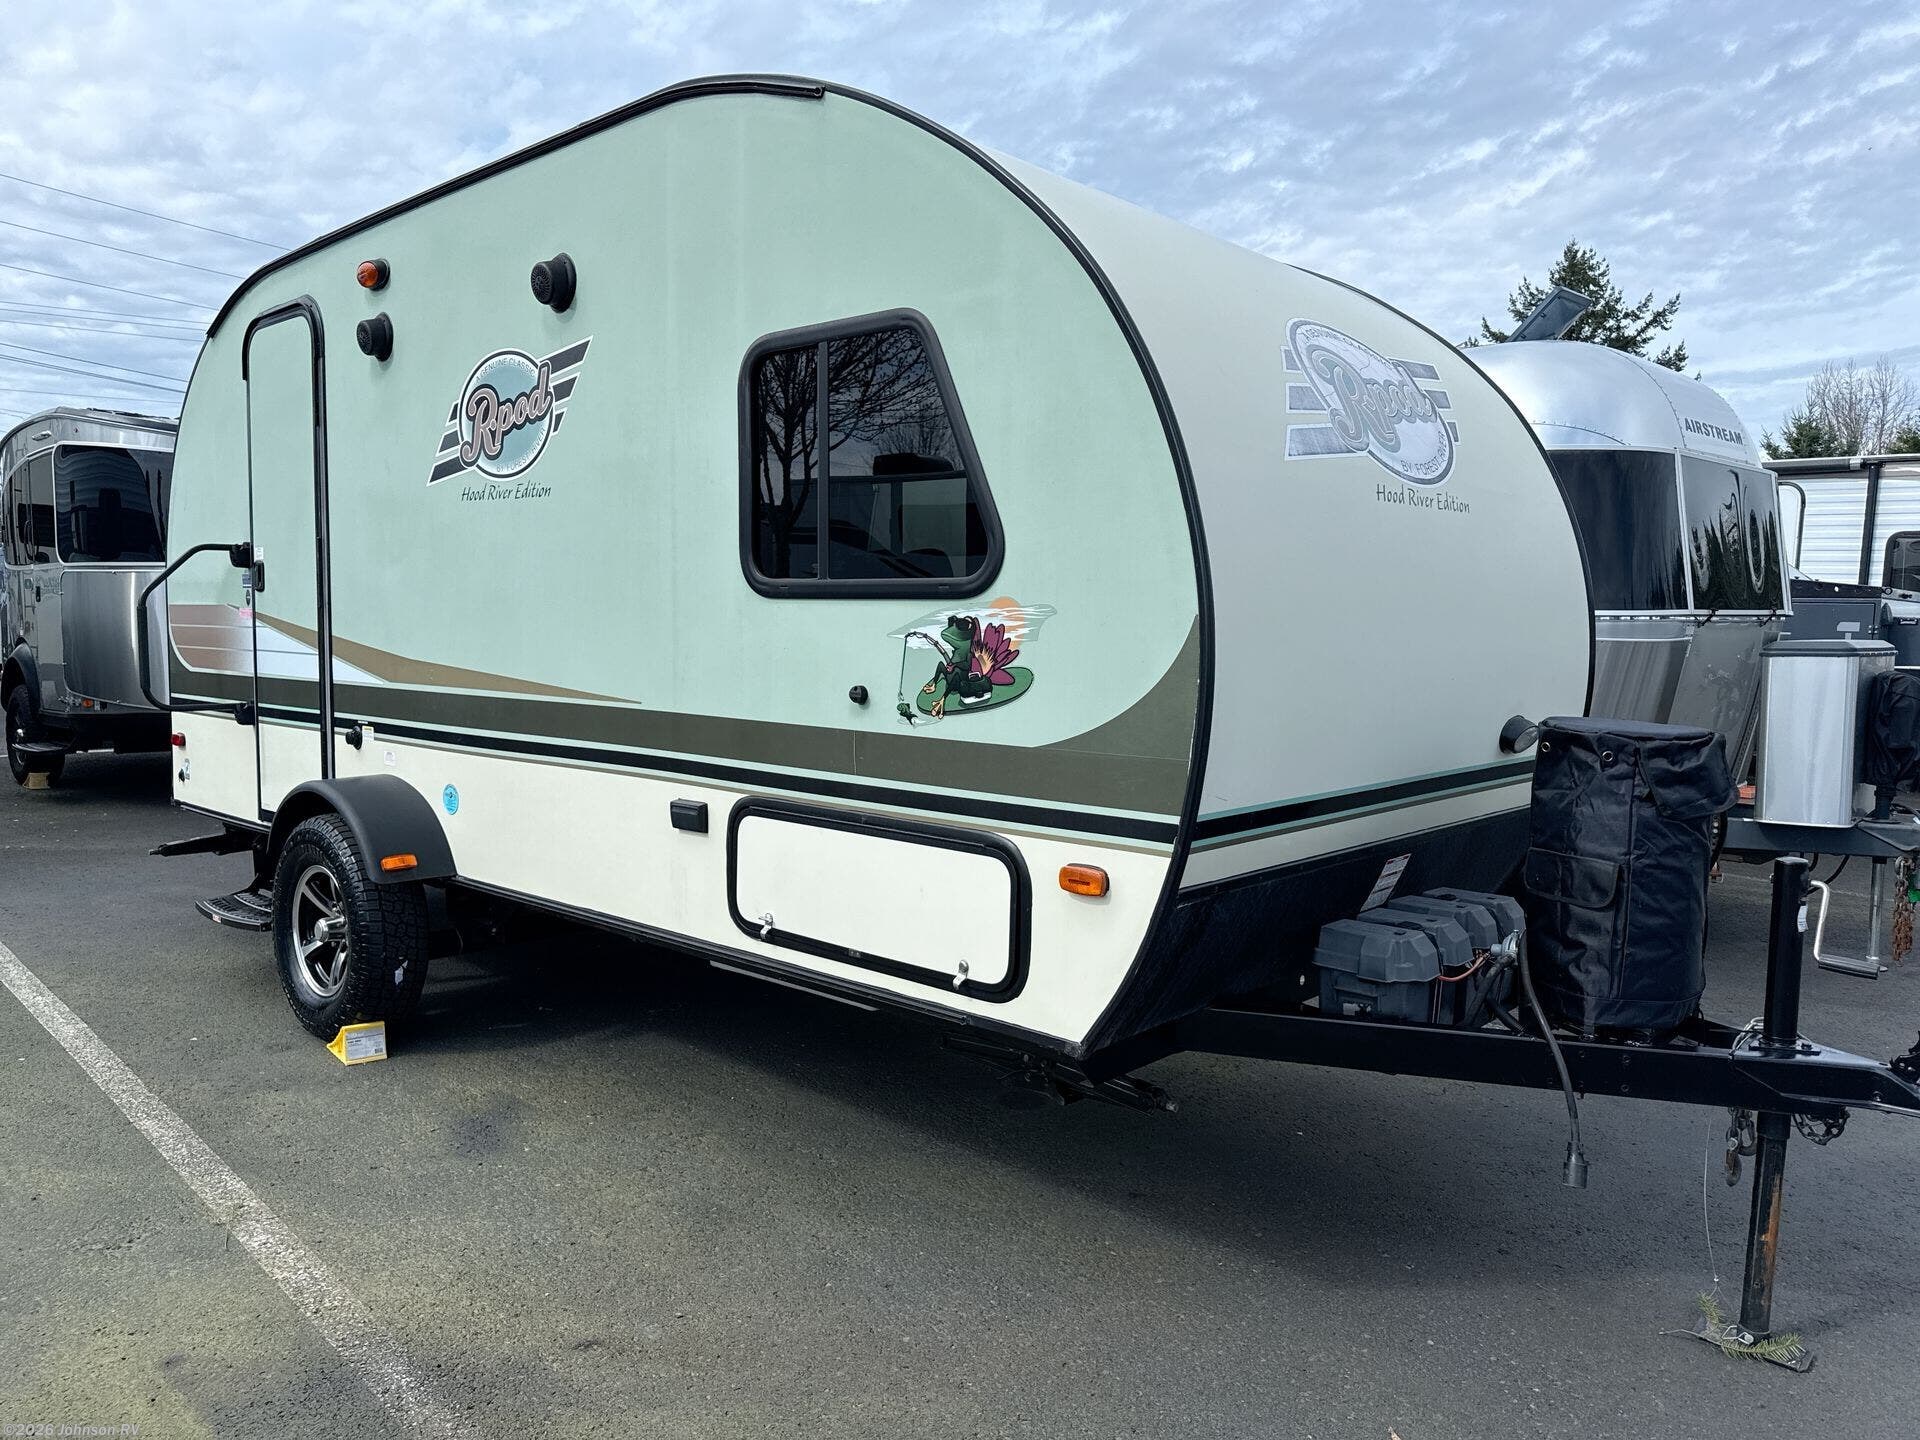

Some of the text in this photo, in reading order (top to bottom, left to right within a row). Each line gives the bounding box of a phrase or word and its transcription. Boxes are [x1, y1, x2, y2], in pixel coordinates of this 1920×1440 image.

[1684, 417, 1743, 445] AIRSTREAM
[461, 479, 551, 501] Hood River Edition
[1376, 483, 1470, 514] Hood River Edition
